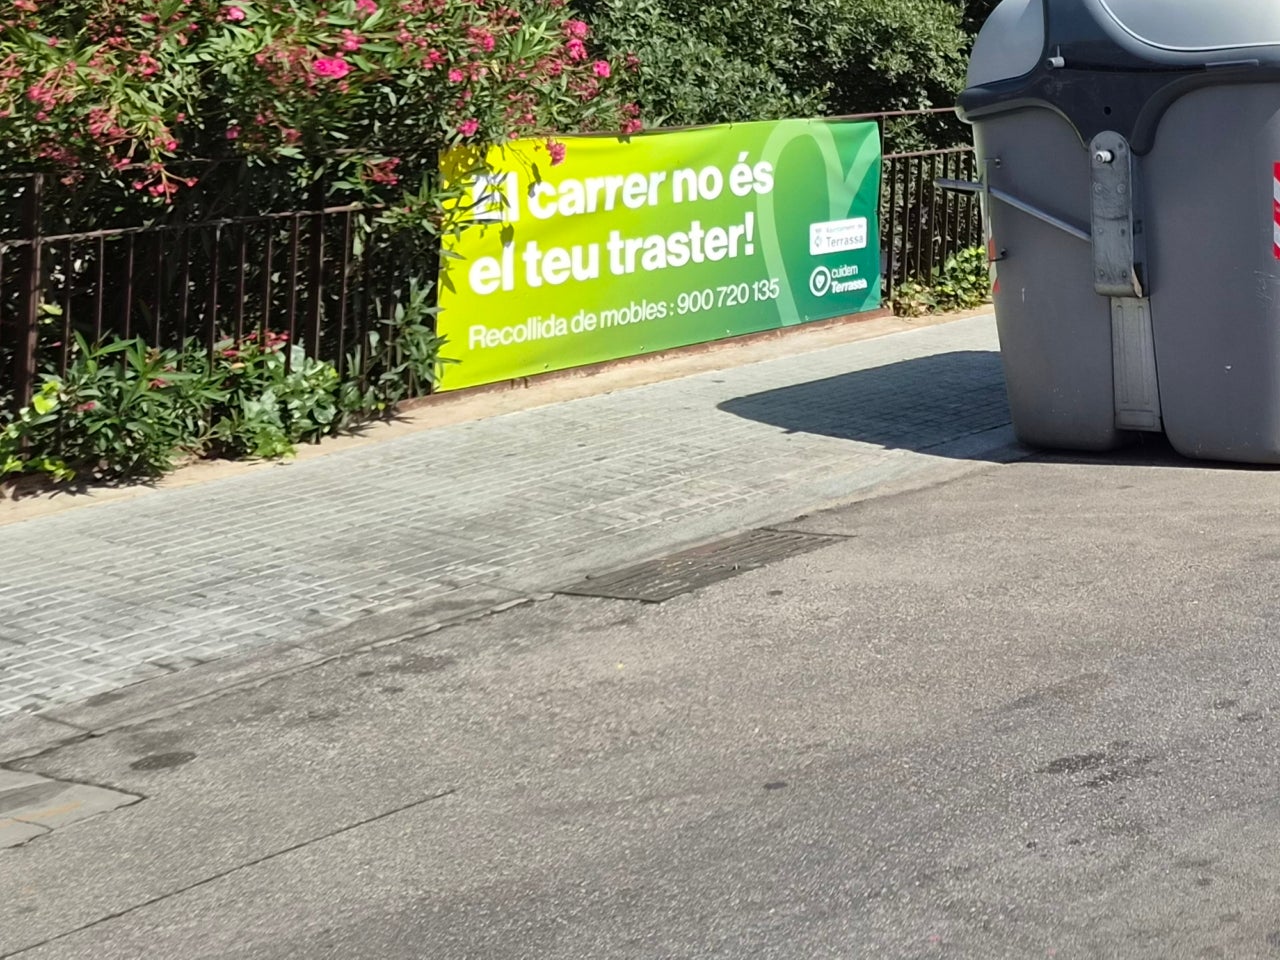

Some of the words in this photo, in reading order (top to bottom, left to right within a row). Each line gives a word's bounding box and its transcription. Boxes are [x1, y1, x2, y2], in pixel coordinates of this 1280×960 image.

[471, 171, 519, 223] El
[528, 172, 666, 220] carrer
[673, 166, 722, 202] no
[729, 152, 774, 196] és
[469, 242, 514, 294] el
[523, 241, 599, 288] teu
[607, 212, 754, 275] traster!
[826, 235, 864, 248] Terrassa
[832, 264, 858, 278] cuidem
[832, 279, 868, 294] Terrassa
[469, 315, 568, 350] Recollida
[571, 309, 597, 333] de
[677, 287, 713, 314] 900
[717, 283, 748, 308] 720
[753, 278, 780, 303] 135
